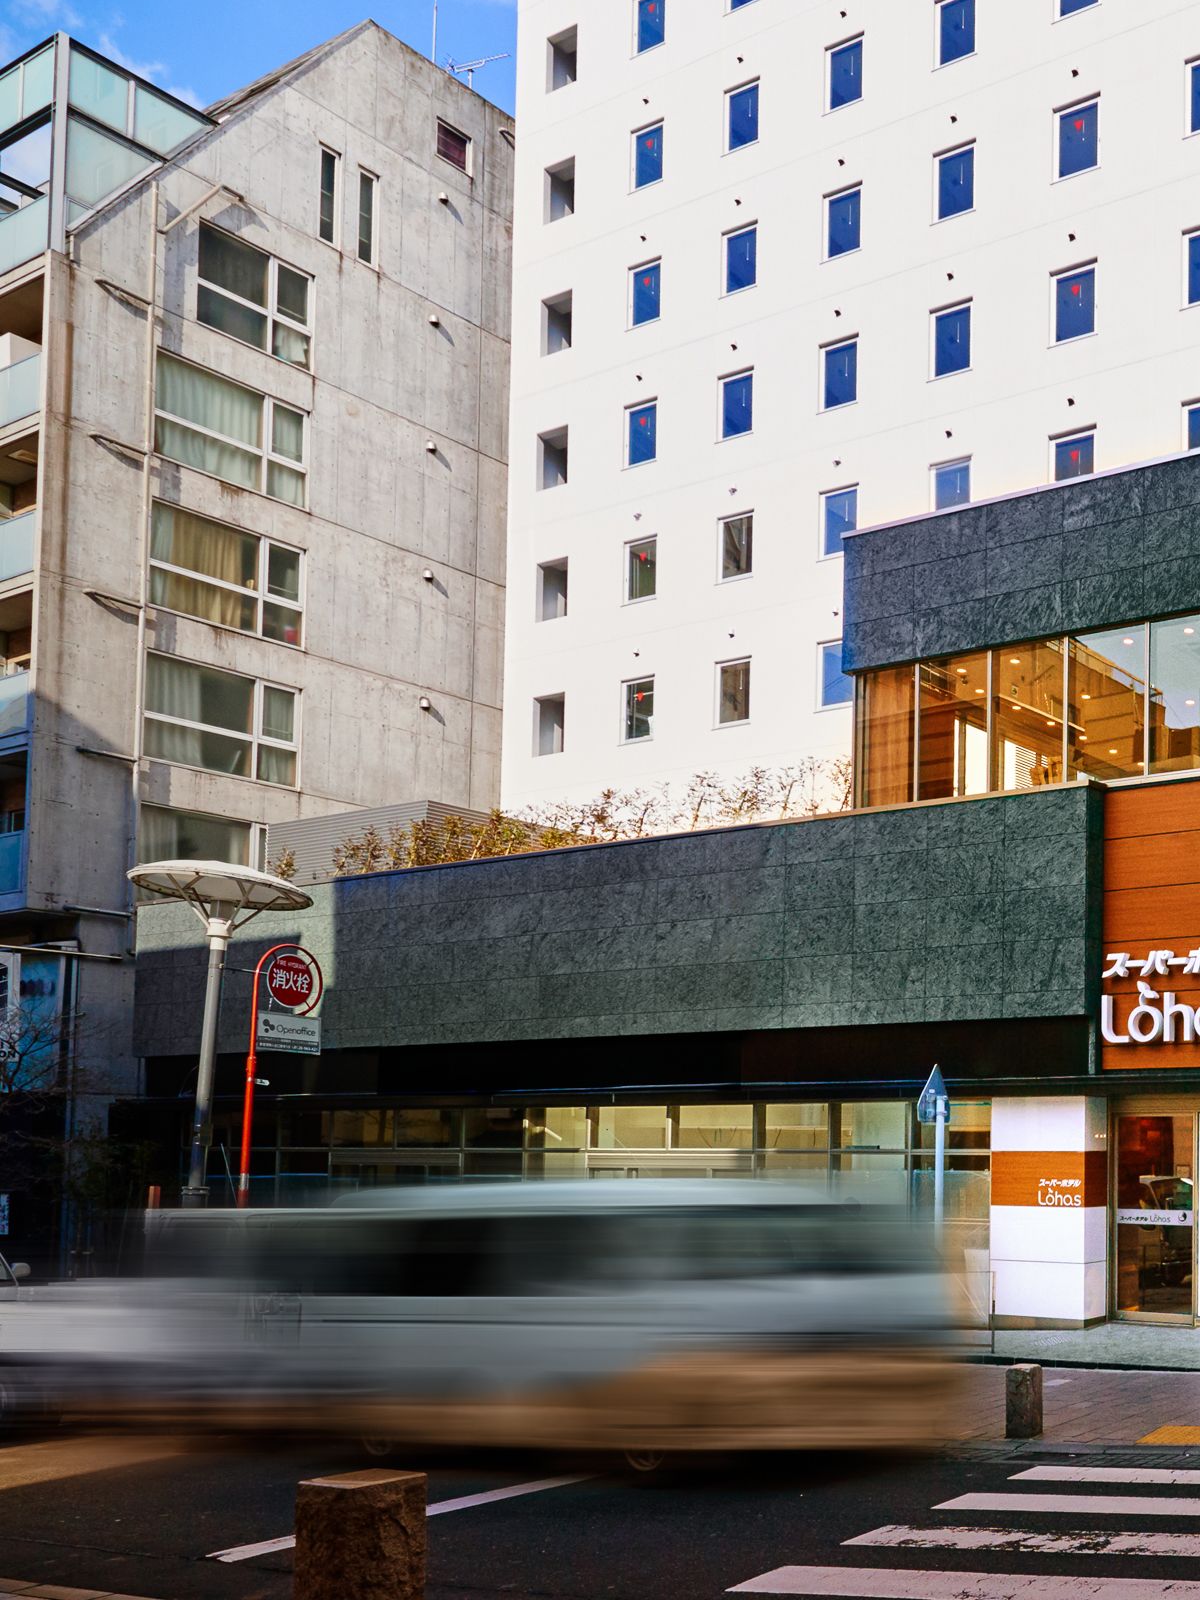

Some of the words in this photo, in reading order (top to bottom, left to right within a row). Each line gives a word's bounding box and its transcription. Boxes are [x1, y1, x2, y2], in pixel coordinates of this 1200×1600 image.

[277, 959, 287, 967] FIRE
[272, 968, 310, 993] 消火栓
[276, 1024, 316, 1037] Openoffice
[1039, 1178, 1081, 1188] スーパーホテル
